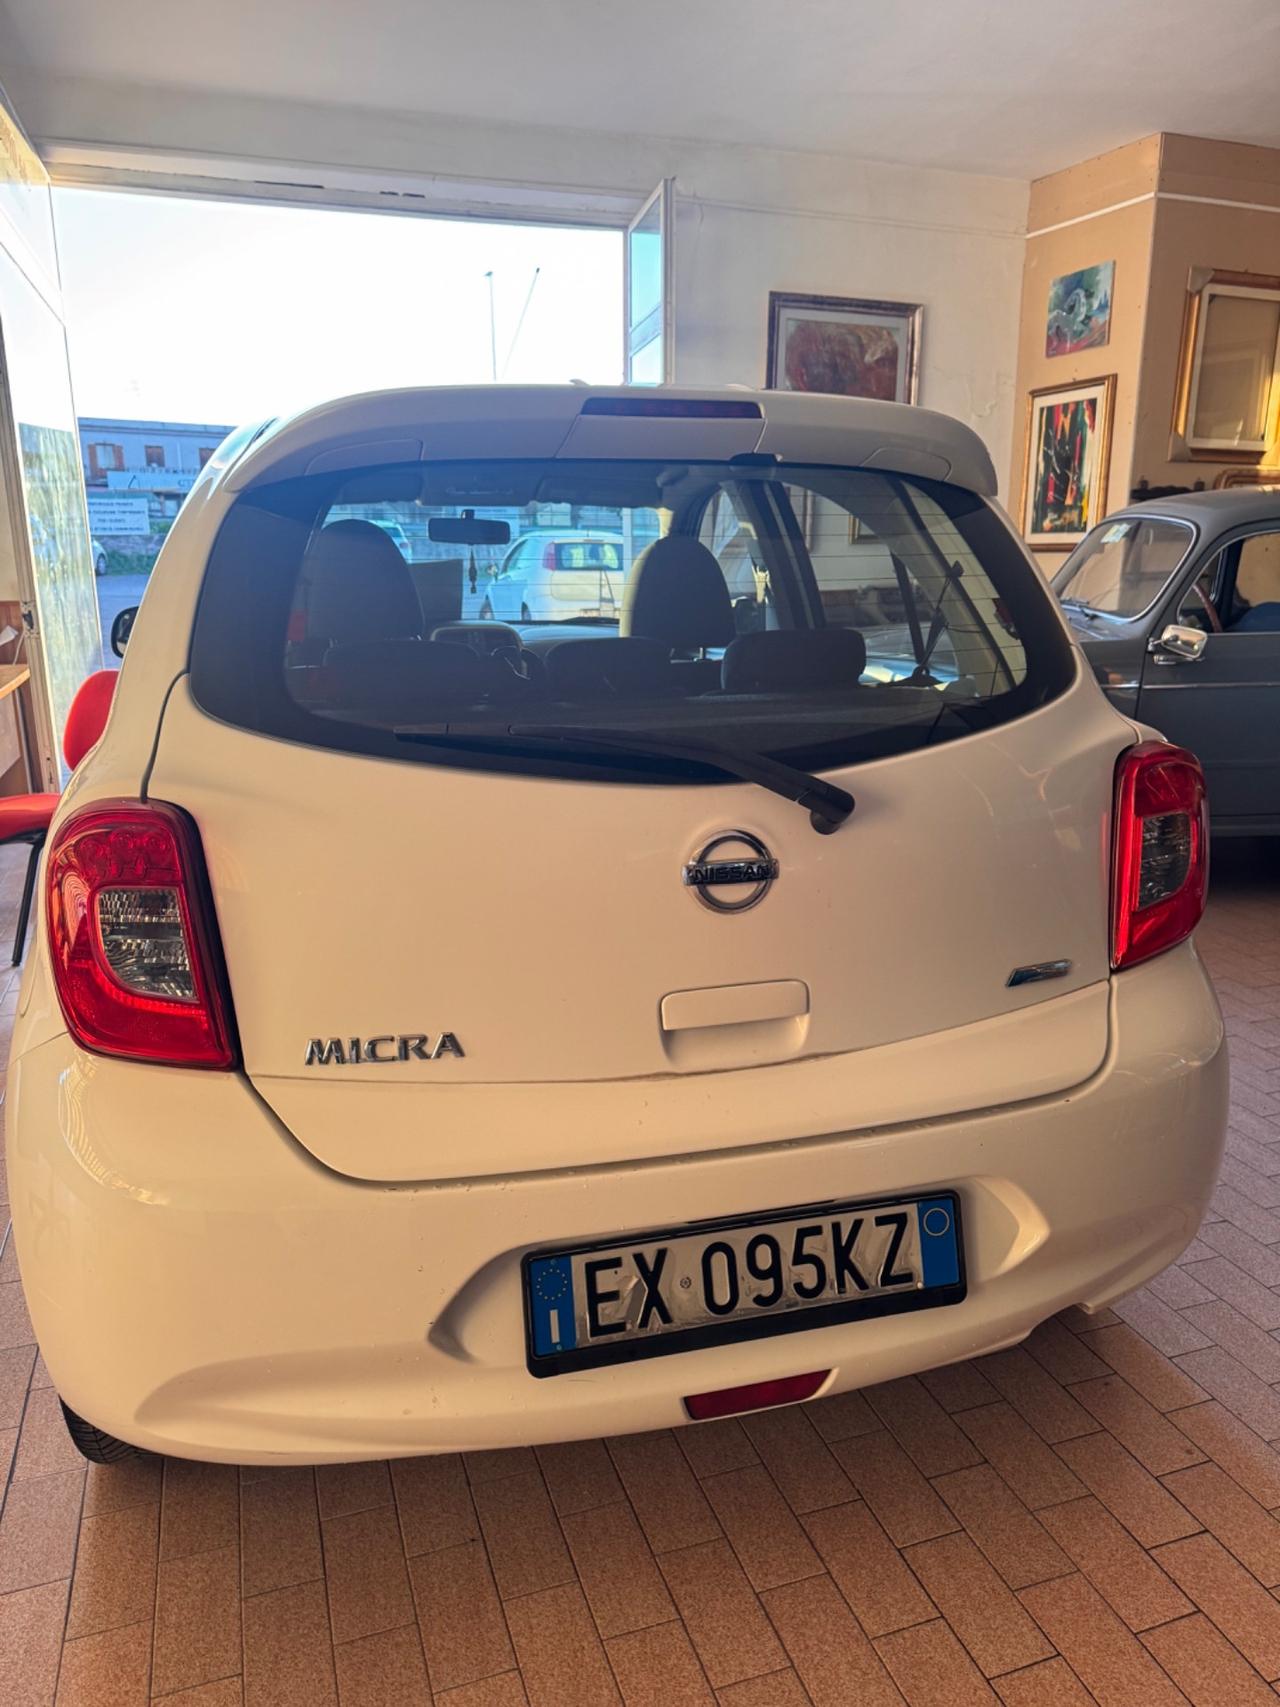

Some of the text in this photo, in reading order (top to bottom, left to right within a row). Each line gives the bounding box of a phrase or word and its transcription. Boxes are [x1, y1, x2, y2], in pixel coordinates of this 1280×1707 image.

[693, 862, 771, 882] NISSAN
[305, 1031, 466, 1066] MICRA
[583, 1211, 914, 1339] EX 095KZ
